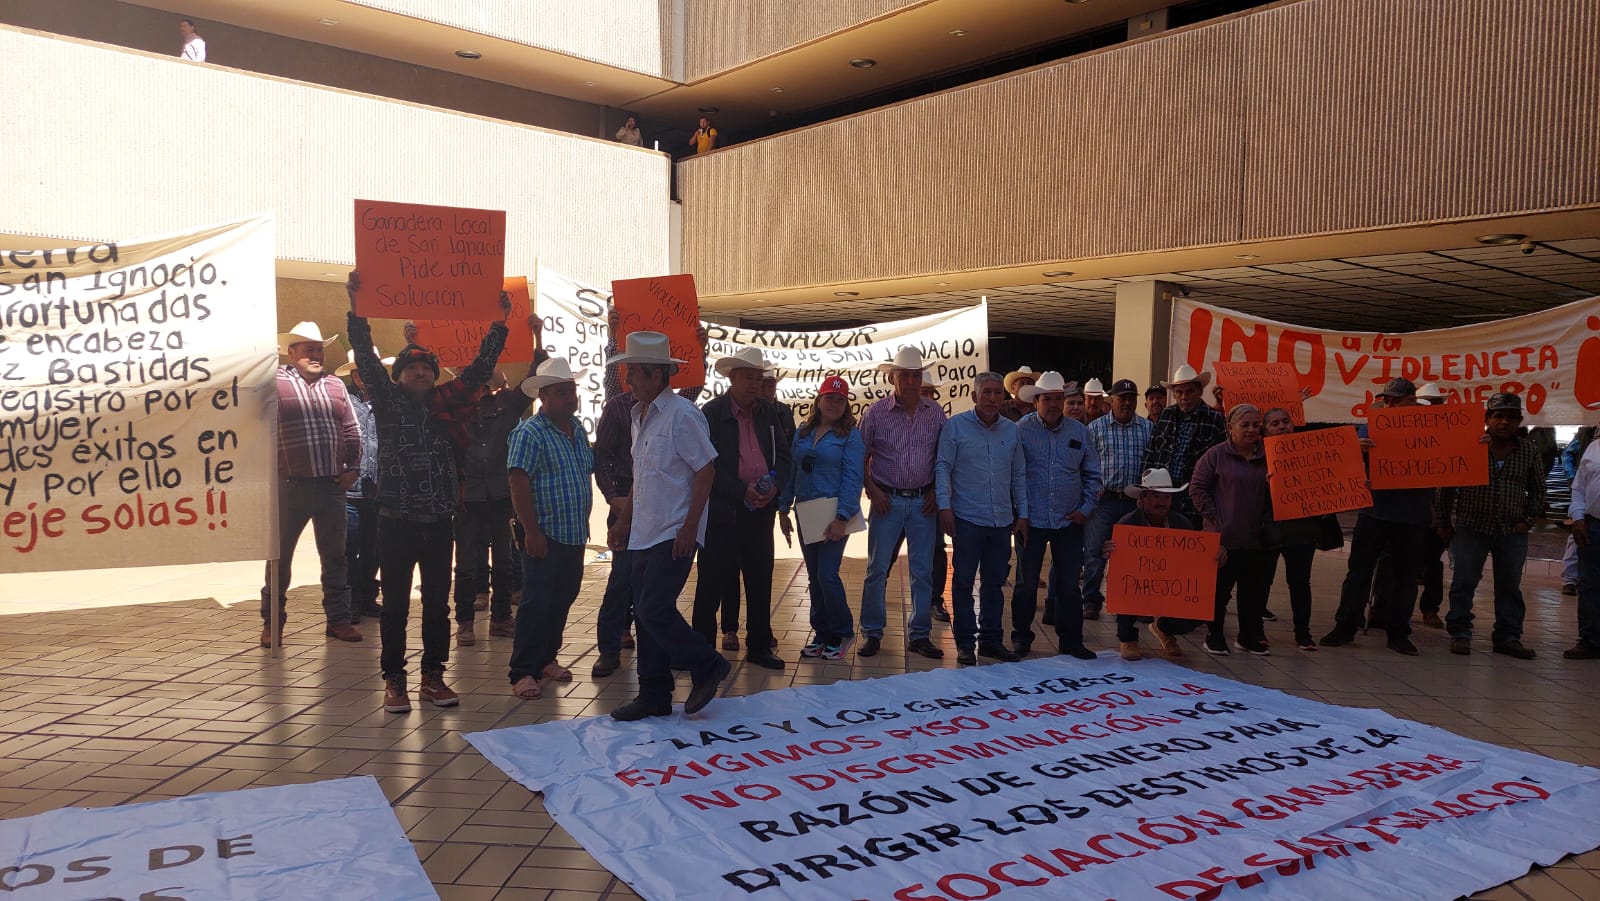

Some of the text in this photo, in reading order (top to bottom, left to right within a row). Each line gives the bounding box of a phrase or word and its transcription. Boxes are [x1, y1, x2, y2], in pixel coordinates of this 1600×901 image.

[361, 207, 492, 235] Ganadera Local
[0, 243, 118, 268] erra
[375, 234, 400, 254] de
[407, 234, 439, 253] San
[400, 256, 483, 280] Pide una
[27, 329, 184, 355] encabeza
[797, 350, 820, 362] de
[830, 348, 873, 363] SAN
[884, 338, 980, 362] INACIO.
[1341, 336, 1362, 351] a
[1372, 333, 1402, 352] la
[48, 352, 211, 385] Bastidas
[938, 364, 977, 381] Para
[1334, 344, 1558, 385] VIOLENCIA
[0, 376, 239, 421] egistro por el
[950, 383, 970, 398] en
[1376, 410, 1471, 431] QUEREMOS
[72, 420, 177, 464] éxitos
[198, 429, 238, 454] en
[1274, 431, 1345, 455] QUEREMOS
[1405, 436, 1440, 449] UNA
[1273, 449, 1344, 473] PARTICIPAR
[1379, 456, 1470, 477] RESPUESTA
[44, 469, 104, 502] por
[119, 459, 182, 495] ello
[205, 459, 234, 485] le
[1284, 467, 1336, 488] EN ESTA
[1280, 477, 1362, 504] CONTIENDA DE
[1127, 532, 1206, 552] QUEREMOS
[1139, 555, 1167, 573] PISO
[764, 719, 799, 734] Y
[807, 707, 901, 729] LOS
[615, 735, 882, 787] EXIGIMOS
[884, 715, 991, 741] PISO
[1160, 682, 1221, 697] LA
[680, 783, 782, 811] NO
[789, 711, 1182, 792] DISCRIMINACIÓN
[739, 717, 1321, 842] RAZÓN DE GENERO PARA
[721, 822, 985, 893] DIRIGIR
[971, 798, 1090, 837] LOS
[1080, 751, 1310, 809] DESTINOS
[148, 833, 256, 871] DE
